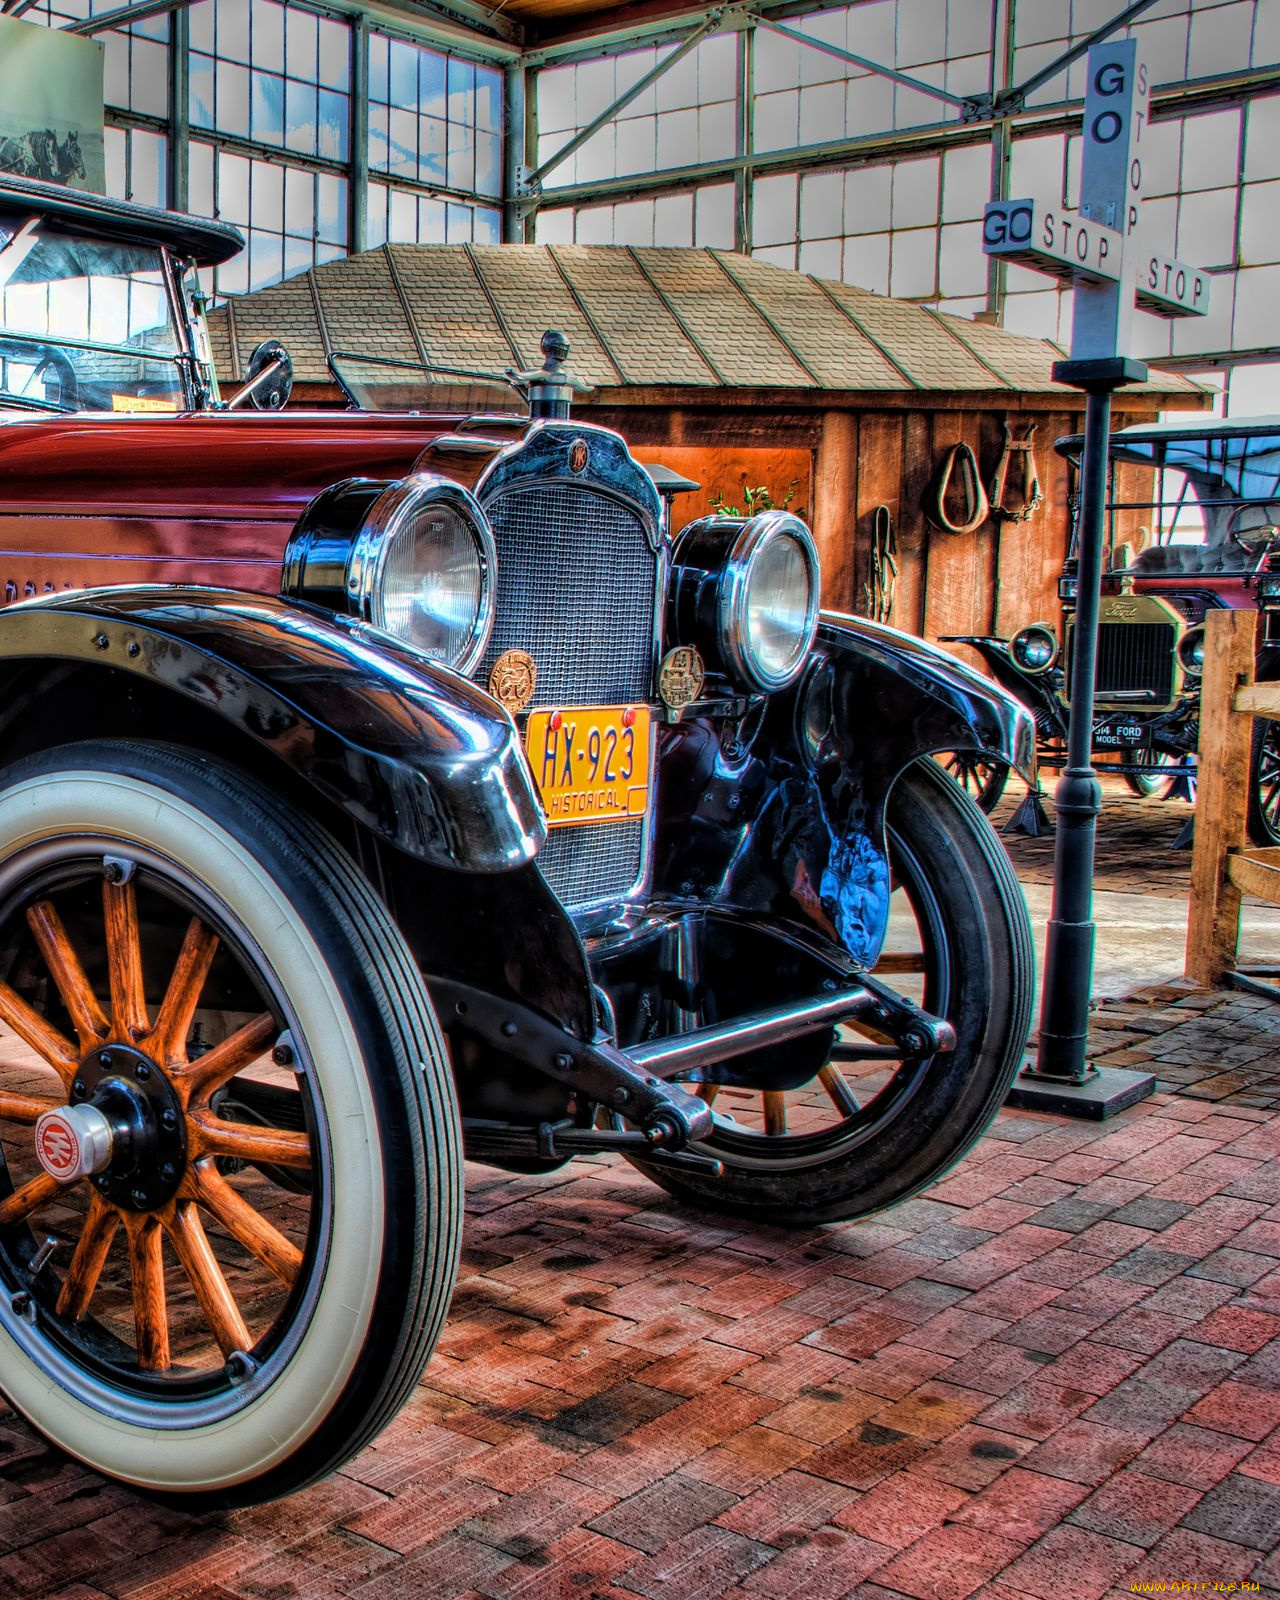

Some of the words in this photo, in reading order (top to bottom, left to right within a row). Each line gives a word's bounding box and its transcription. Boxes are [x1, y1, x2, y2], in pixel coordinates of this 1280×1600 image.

[1091, 63, 1124, 144] GO
[1128, 63, 1147, 235] STOP
[982, 208, 1032, 245] GO
[1043, 213, 1108, 268] STOP
[1148, 257, 1202, 305] STOP
[1104, 601, 1138, 619] Ford
[1096, 736, 1122, 744] MODEL
[1116, 726, 1142, 737] FORD
[541, 722, 634, 788] HX-923
[551, 789, 620, 814] HISTORICAL
